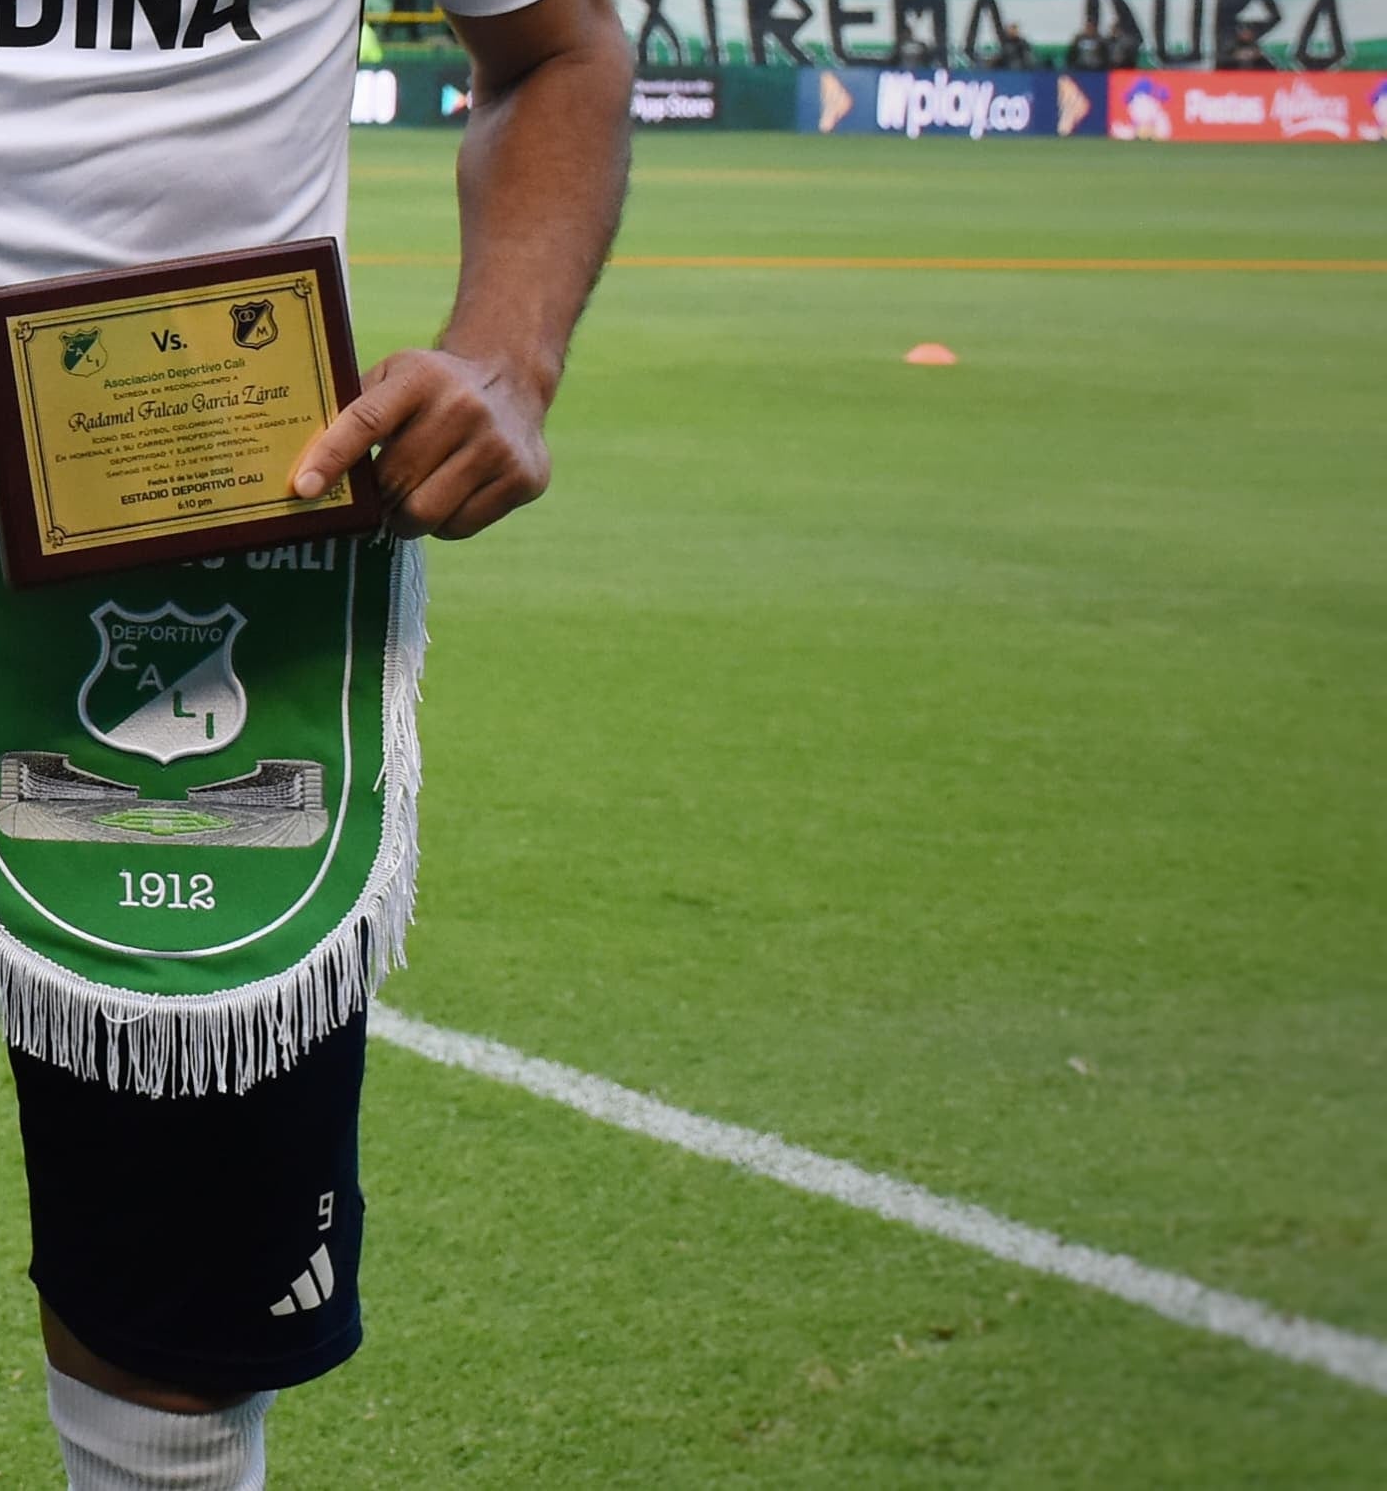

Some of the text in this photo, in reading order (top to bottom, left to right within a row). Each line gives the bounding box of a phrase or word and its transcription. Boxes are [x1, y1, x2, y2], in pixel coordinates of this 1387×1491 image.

[667, 93, 715, 119] Store
[150, 326, 188, 354] Vs.
[166, 360, 222, 381] Deportivo
[222, 356, 245, 370] Cali
[66, 403, 136, 435] Radamel
[136, 394, 189, 421] Falcao
[119, 471, 264, 505] ESTADIO DEPORTIVO CALI
[196, 497, 213, 508] pm
[111, 624, 224, 644] DEPORTIVO
[109, 643, 215, 740] CALI
[118, 869, 216, 911] 1912
[318, 1190, 335, 1231] 9
